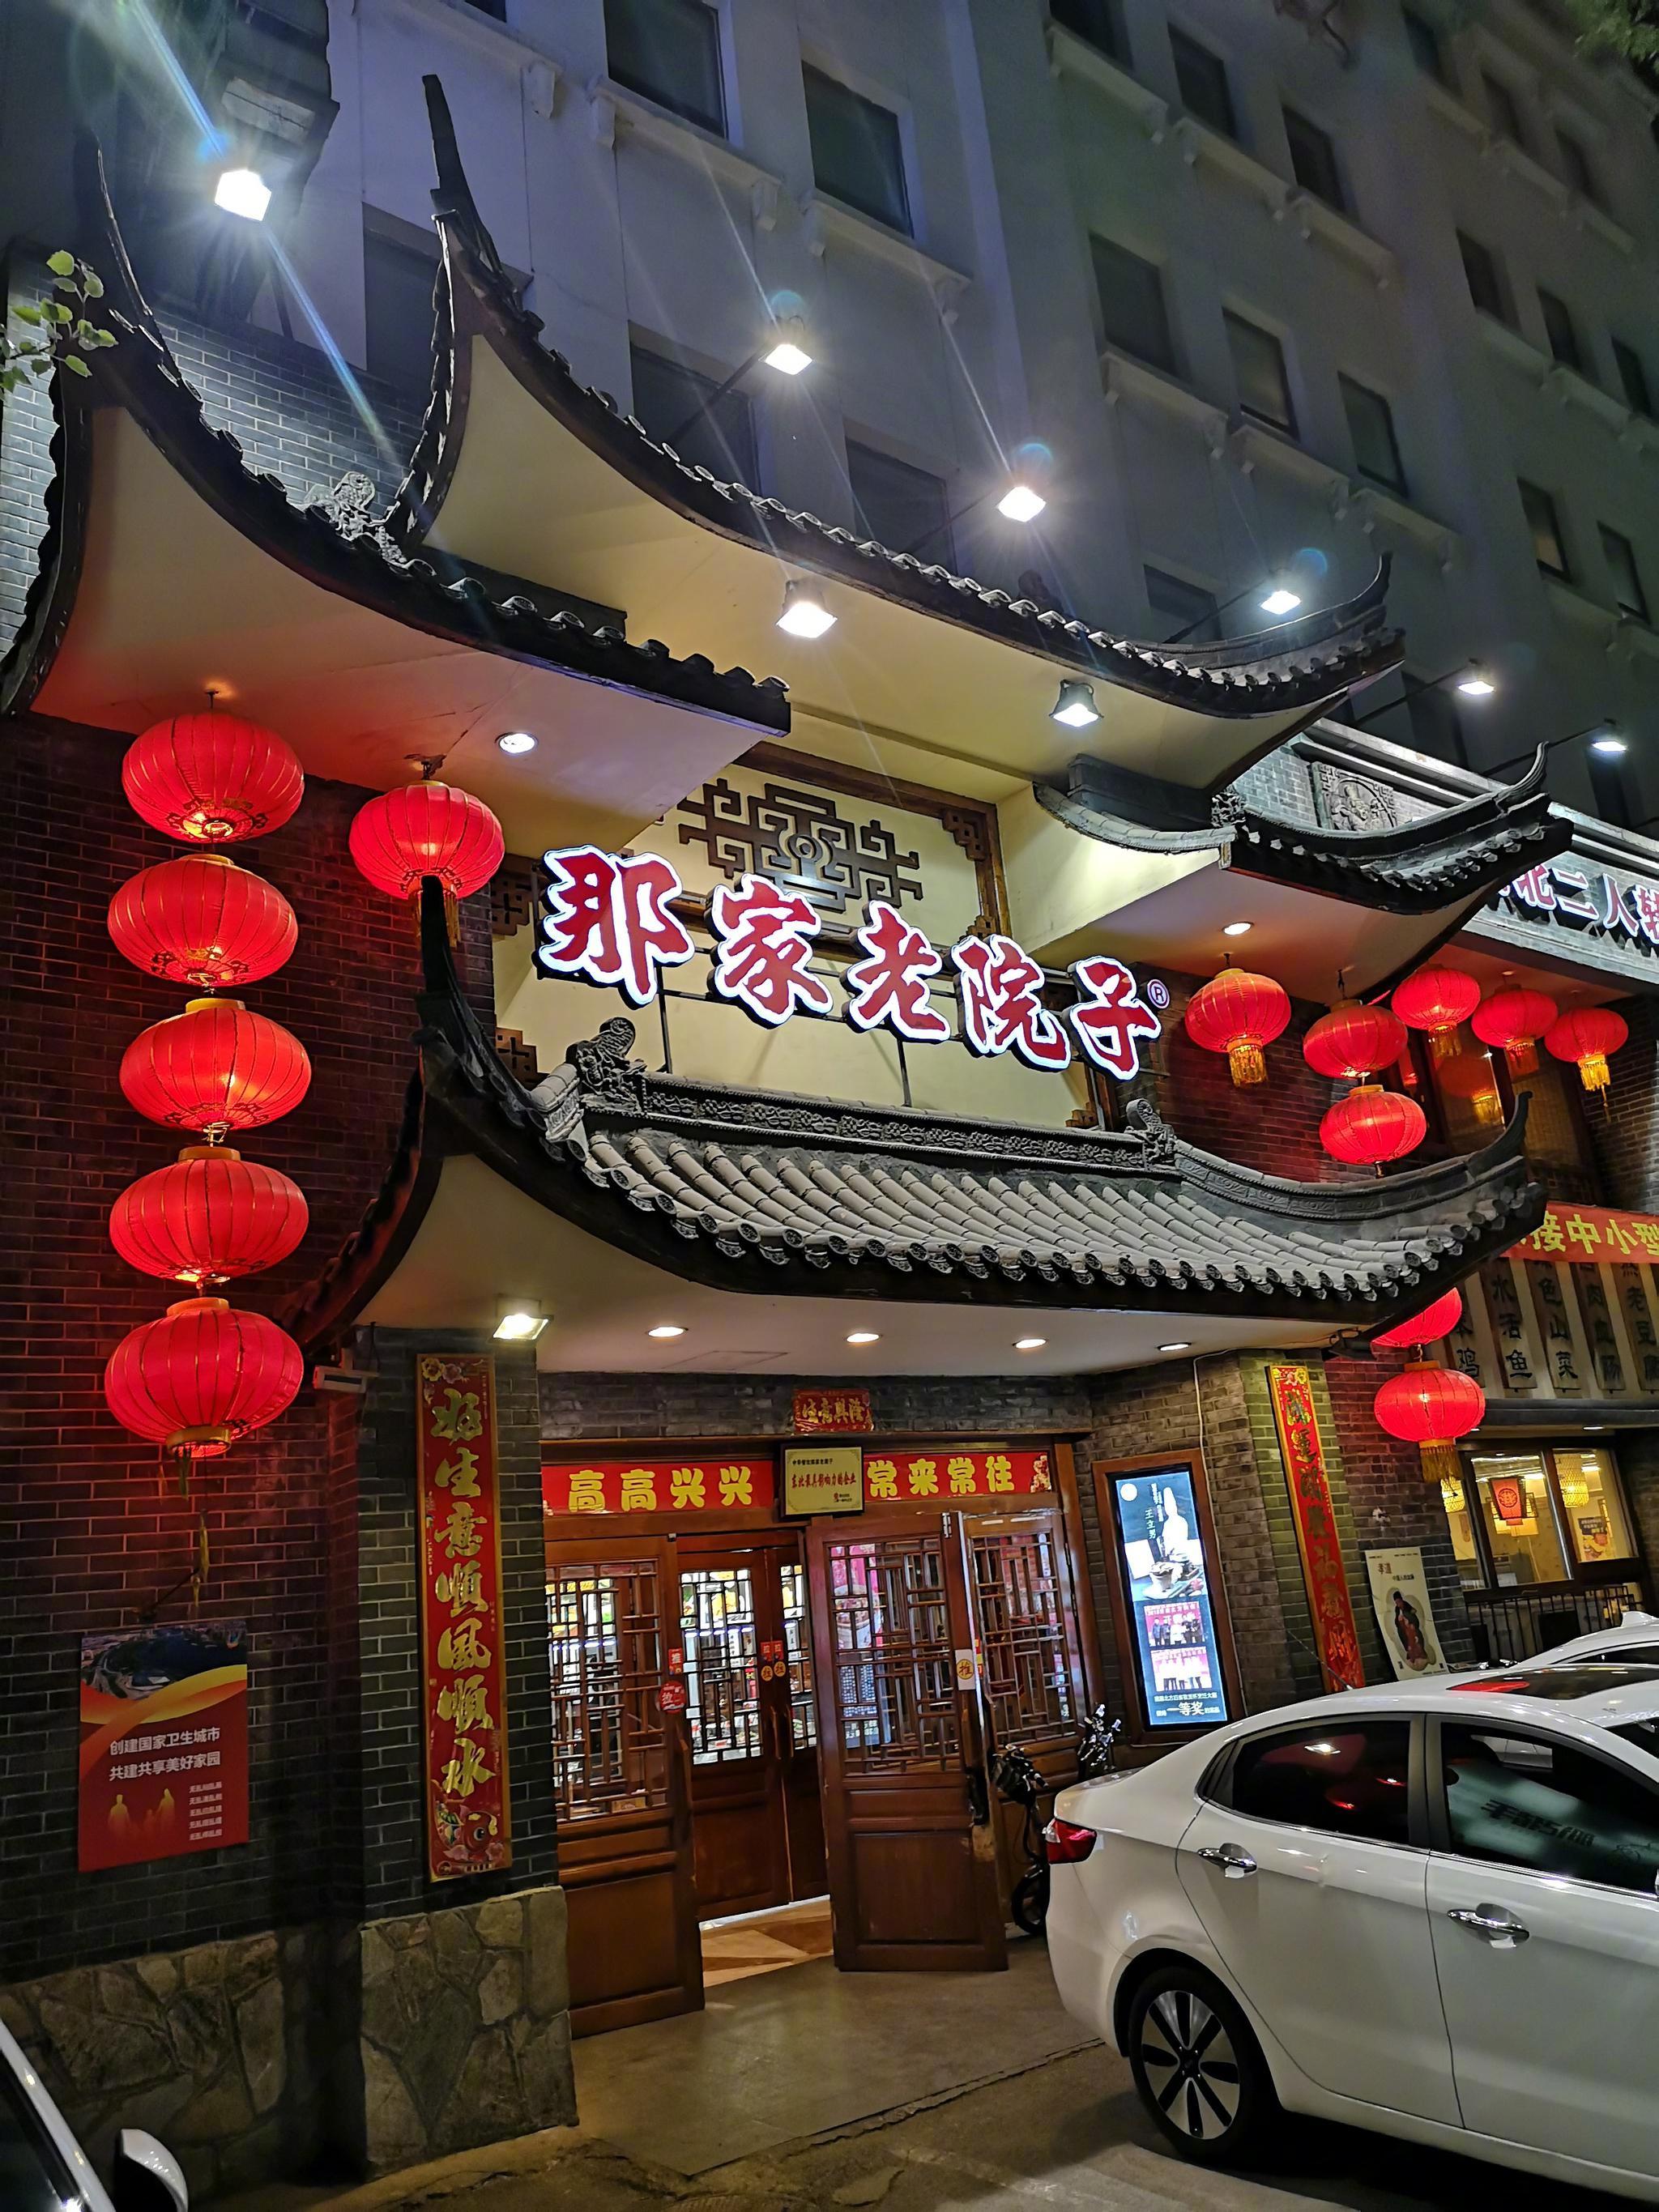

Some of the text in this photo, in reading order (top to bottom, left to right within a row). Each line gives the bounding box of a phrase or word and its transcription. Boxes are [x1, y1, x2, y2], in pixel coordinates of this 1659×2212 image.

[541, 845, 1162, 1080] 那家老院子
[1534, 1261, 1580, 1379] 色山菜
[569, 1466, 753, 1513] 高高兴兴
[867, 1455, 1015, 1499] 常来常往
[958, 1660, 972, 1676] 推
[109, 1726, 221, 1756] 创建国家卫生城市
[109, 1750, 221, 1782] 共建共享美好家园
